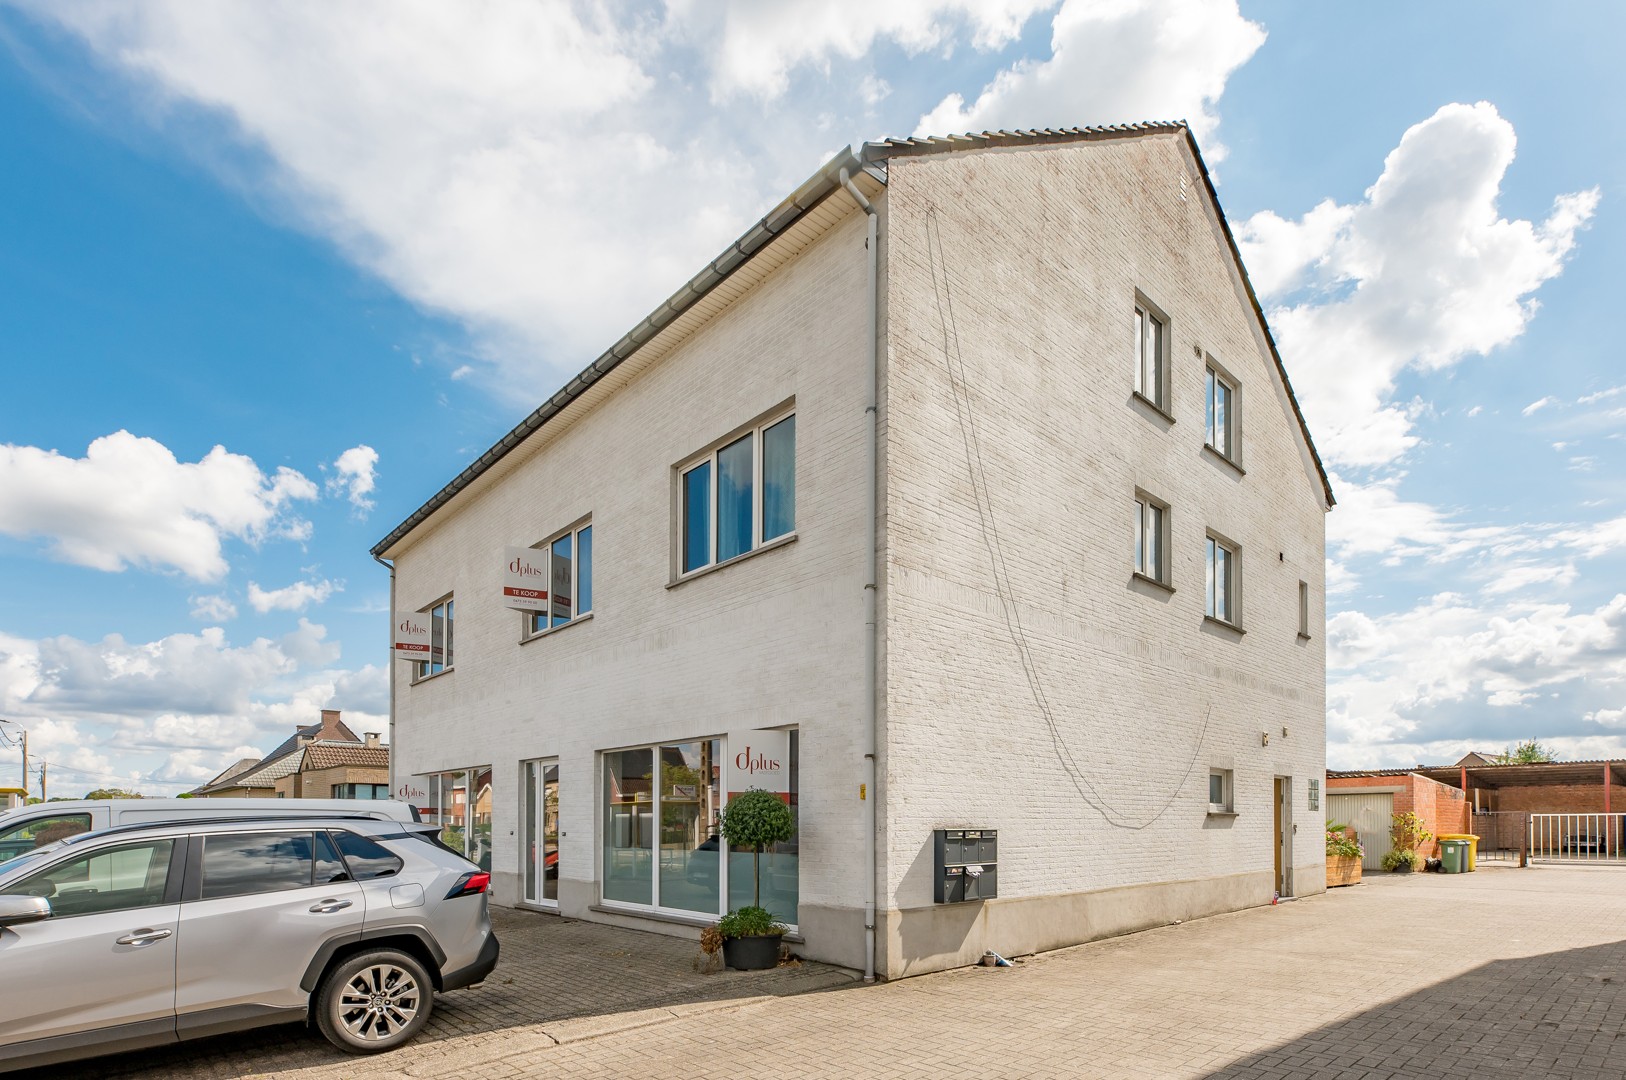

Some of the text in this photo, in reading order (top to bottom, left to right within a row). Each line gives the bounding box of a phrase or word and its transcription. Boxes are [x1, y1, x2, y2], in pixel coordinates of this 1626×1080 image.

[509, 557, 542, 577] dplus
[400, 620, 427, 635] dplus
[735, 746, 780, 775] dplus
[399, 784, 425, 800] dplus
